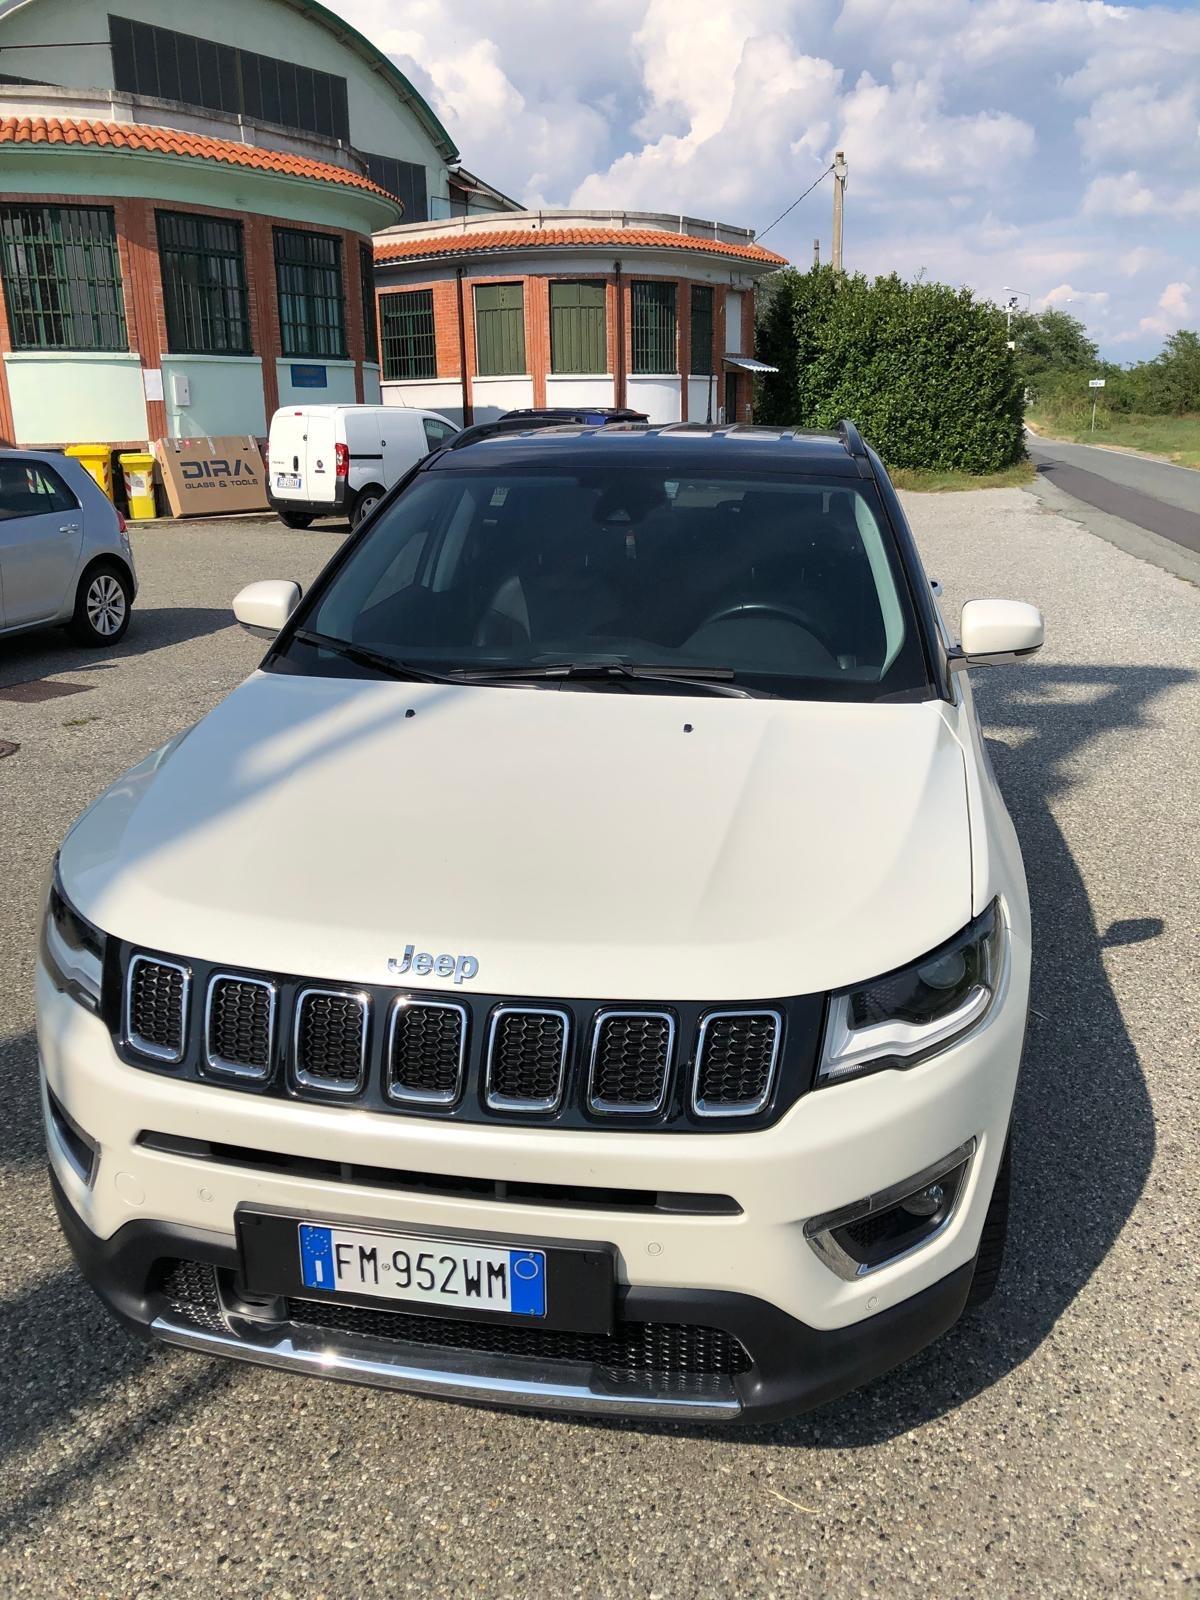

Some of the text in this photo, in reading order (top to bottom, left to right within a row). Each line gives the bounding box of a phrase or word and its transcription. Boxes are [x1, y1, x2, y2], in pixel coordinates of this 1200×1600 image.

[180, 459, 255, 479] DIRA
[185, 481, 216, 489] GLASS
[219, 480, 227, 488] &
[387, 944, 480, 985] Jeep
